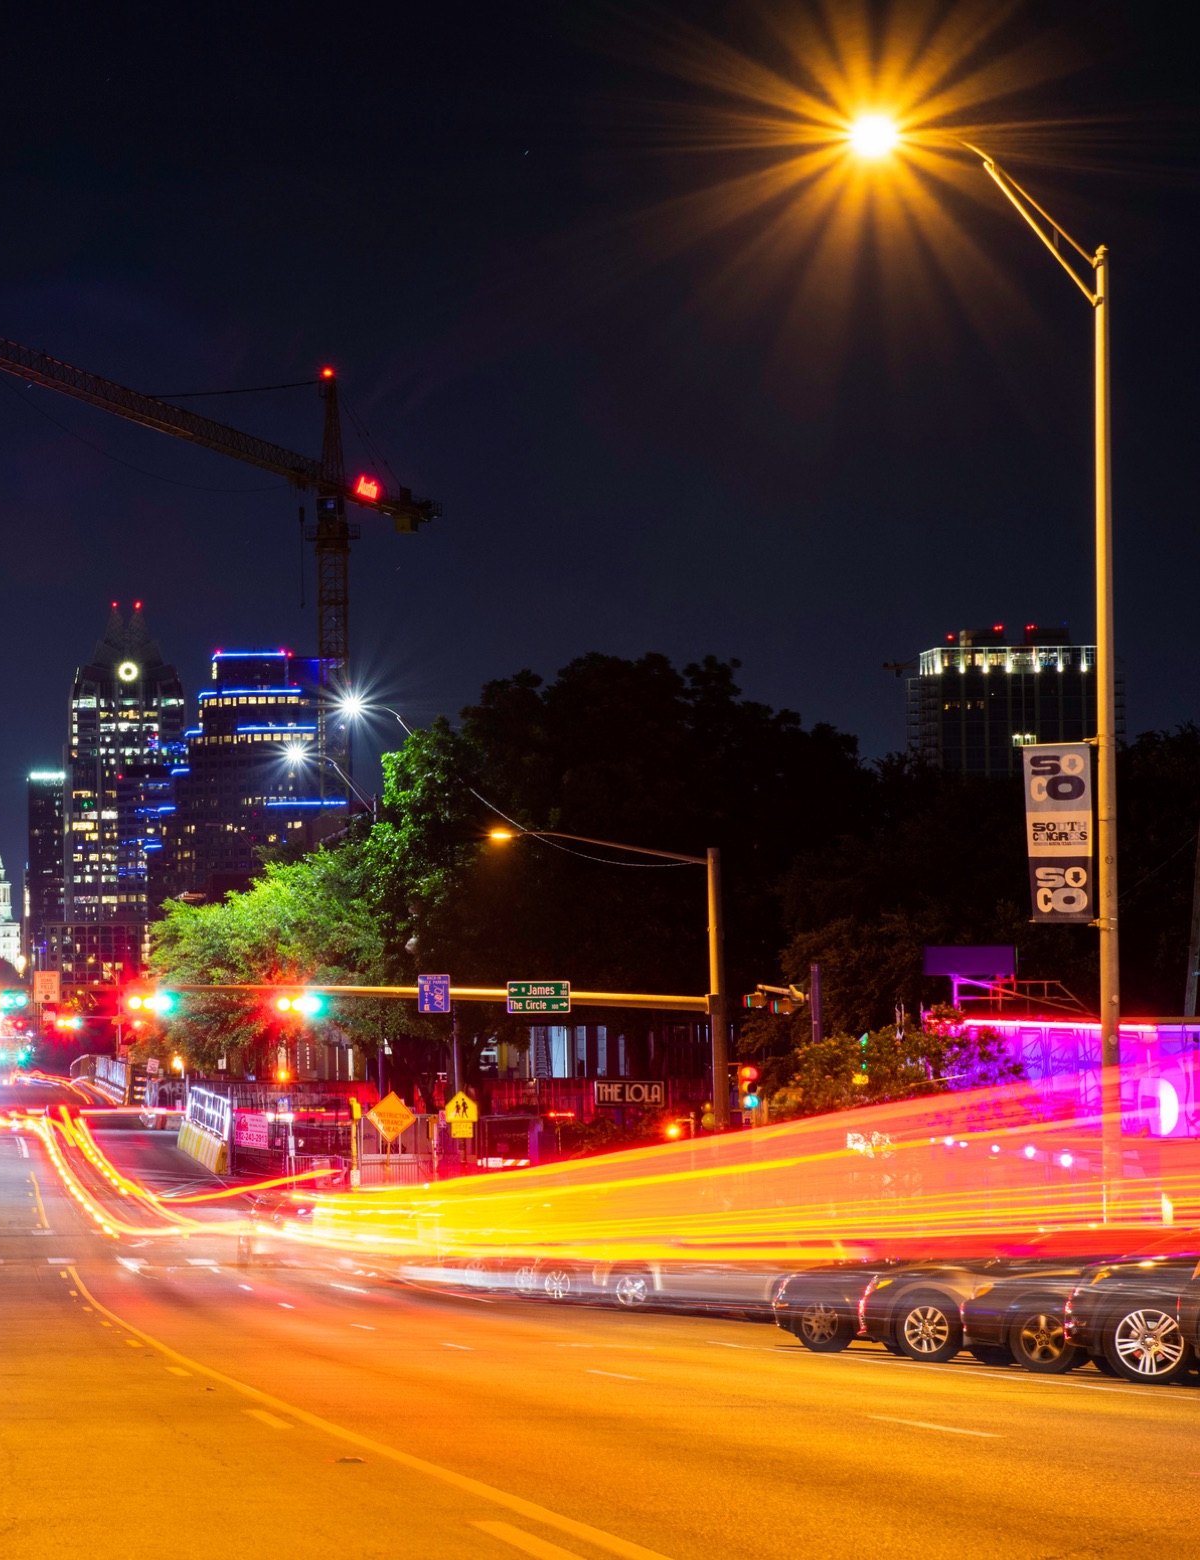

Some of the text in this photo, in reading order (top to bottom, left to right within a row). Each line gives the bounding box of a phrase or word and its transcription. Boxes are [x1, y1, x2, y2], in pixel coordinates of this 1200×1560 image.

[1032, 822, 1087, 832] SOUTH
[1032, 831, 1088, 841] CONGRESS
[527, 984, 555, 995] James
[509, 1000, 523, 1010] The
[525, 1000, 547, 1010] Circle
[597, 1083, 660, 1102] THE LOLA
[373, 1111, 410, 1120] CONSTRUCTION
[377, 1118, 404, 1126] ENTRANCE
[382, 1125, 400, 1133] AHEAD
